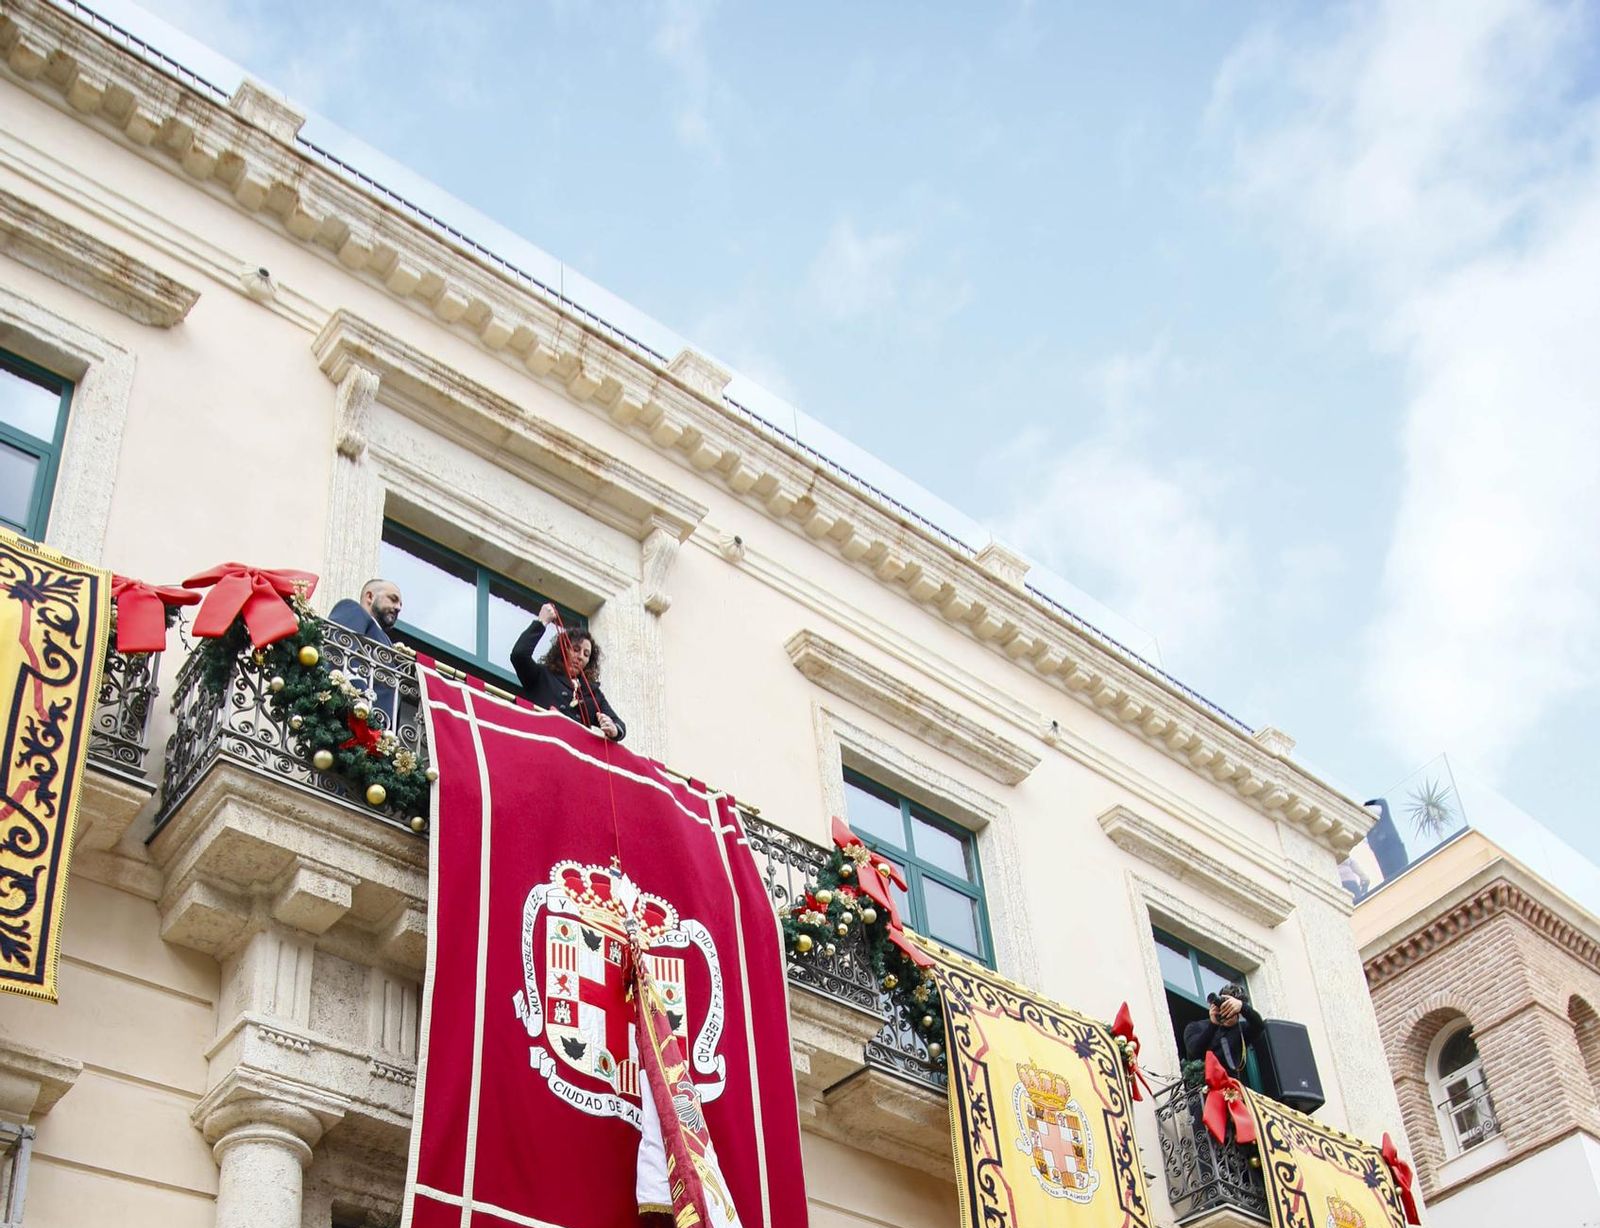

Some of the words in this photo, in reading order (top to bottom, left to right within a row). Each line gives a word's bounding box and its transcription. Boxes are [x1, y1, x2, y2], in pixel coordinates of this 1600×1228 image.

[558, 898, 567, 910] Y
[524, 909, 534, 936] MUY
[695, 929, 717, 959] DIDA
[524, 938, 534, 980] NOBLE
[713, 965, 722, 992] POR
[530, 988, 541, 1015] MUY
[713, 995, 722, 1009] LA
[697, 1013, 722, 1063] LIBERTAD
[553, 1081, 603, 1110] CIUDAD
[608, 1099, 622, 1113] DE
